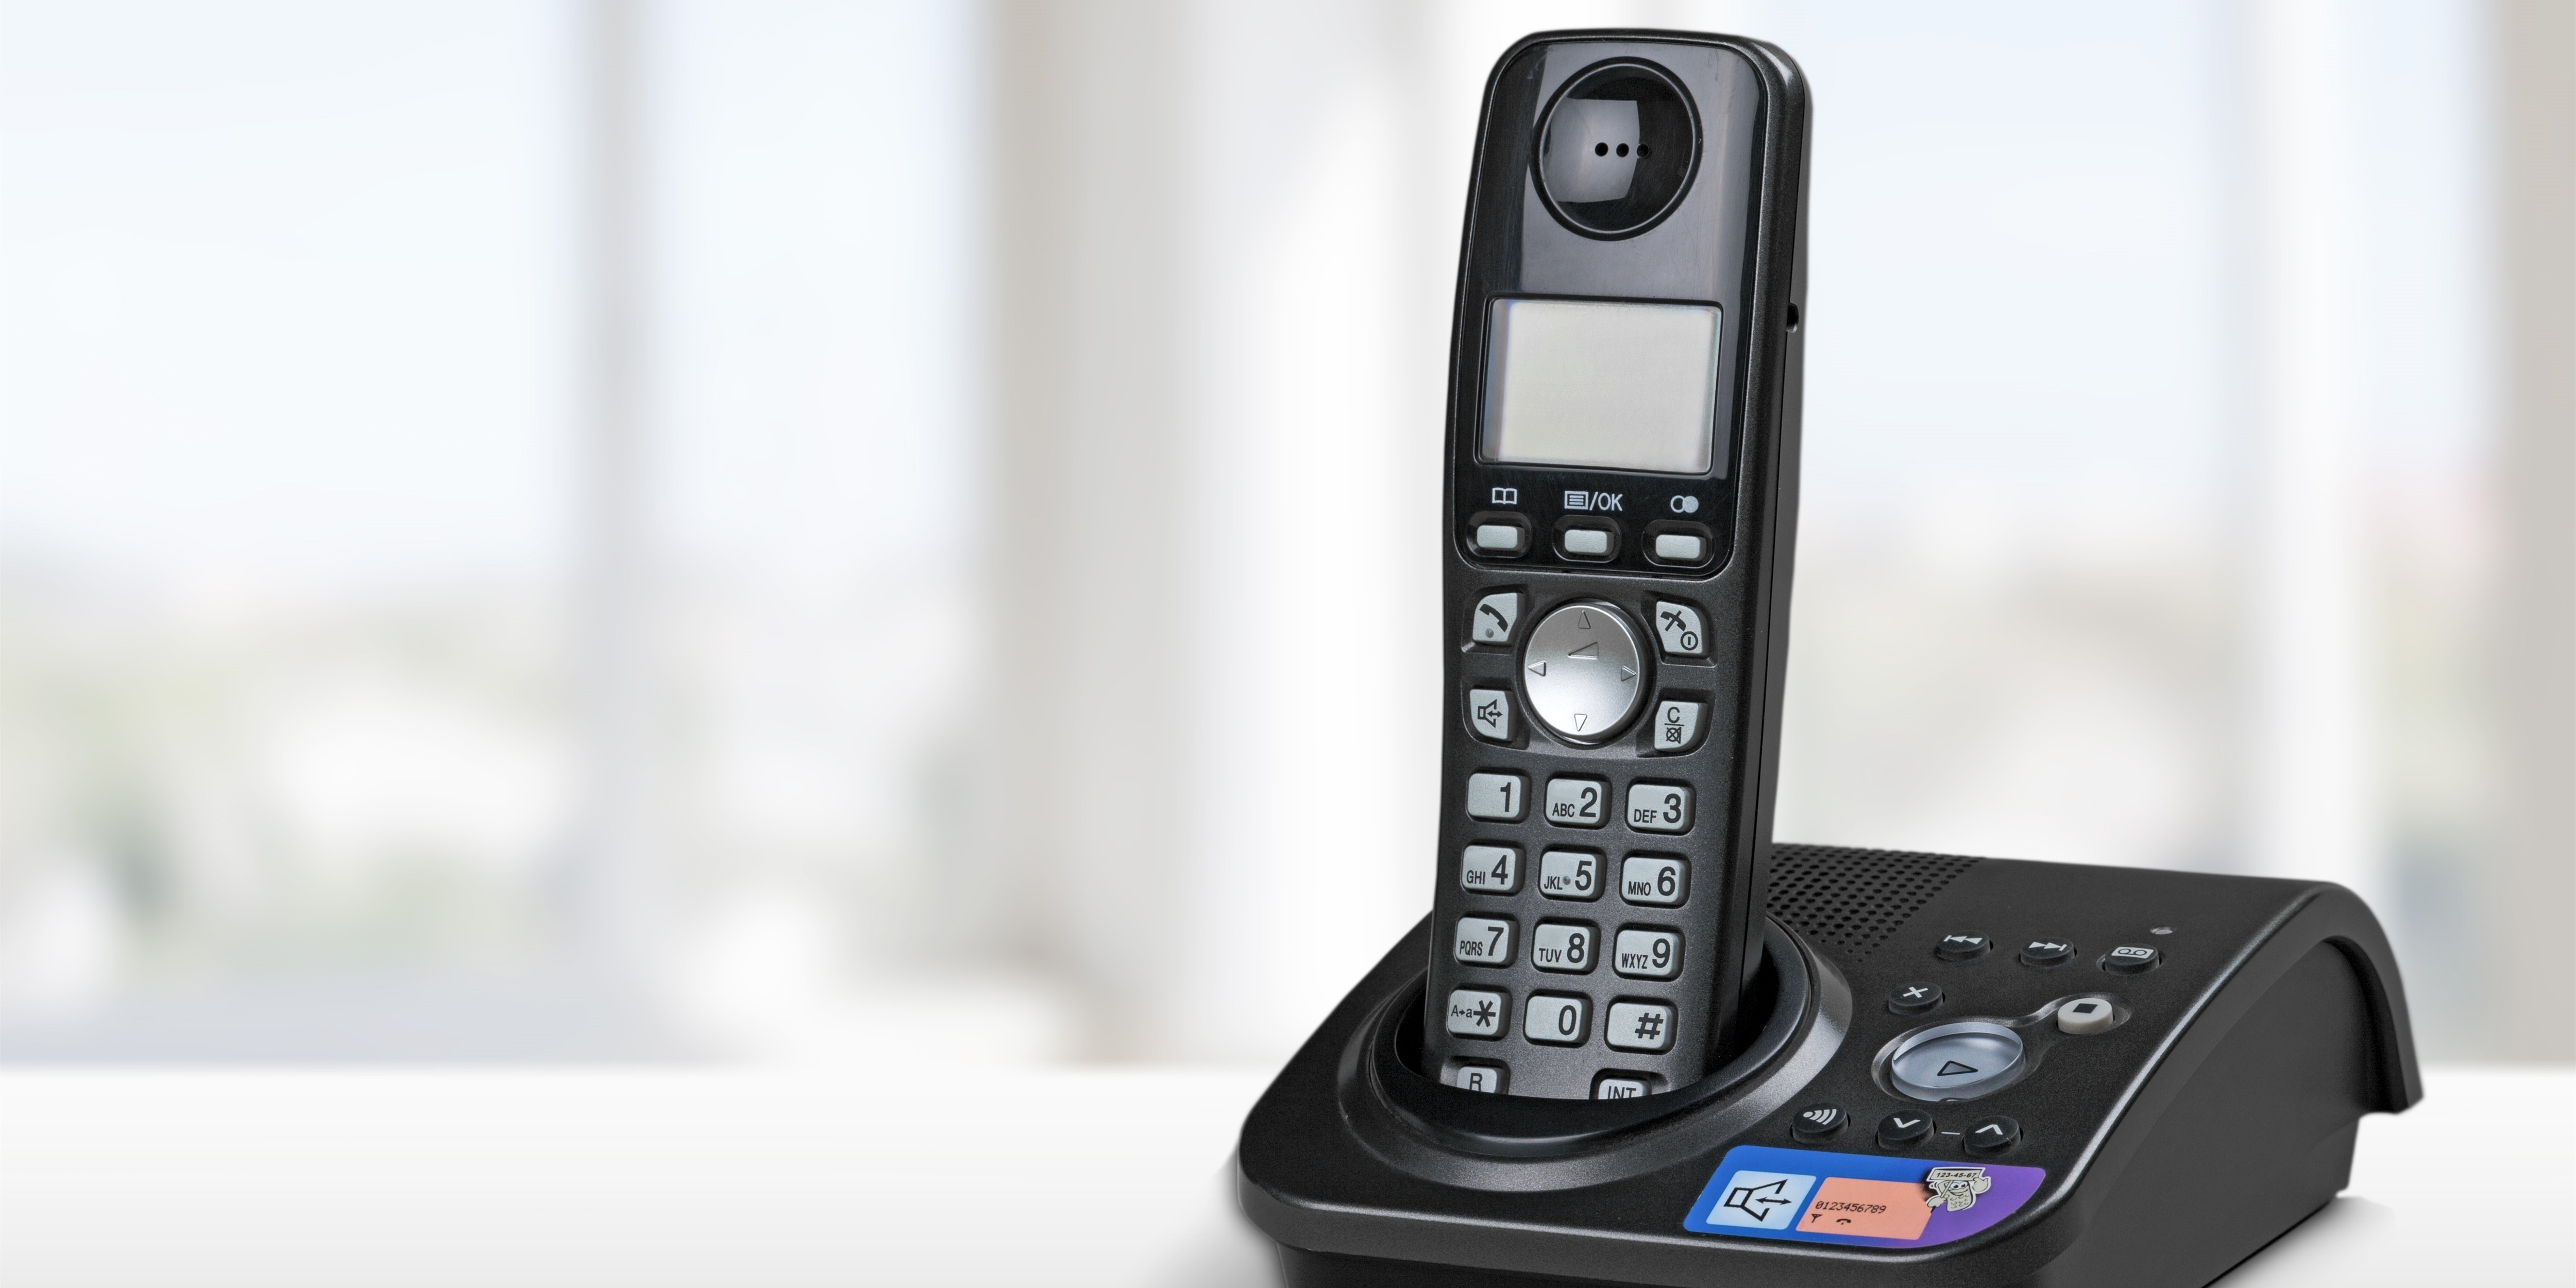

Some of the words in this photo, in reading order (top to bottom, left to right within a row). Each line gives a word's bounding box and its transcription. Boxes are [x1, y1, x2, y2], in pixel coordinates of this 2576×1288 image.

[1667, 706, 1680, 723] C
[1500, 782, 1512, 812] 1
[1552, 802, 1575, 818] ABC
[1579, 787, 1598, 818] 2
[1633, 808, 1657, 824] DEF
[1663, 793, 1682, 824] 3
[1466, 870, 1486, 885] GHI
[1491, 855, 1509, 885] 4
[1544, 875, 1563, 890] JKL
[1574, 860, 1592, 891] 5
[1628, 880, 1651, 896] MNO
[1657, 866, 1676, 896] 6
[1459, 940, 1483, 957] PQRS
[1487, 926, 1504, 956] 7
[1538, 947, 1562, 963] TUV
[1567, 933, 1585, 963] 8
[1621, 953, 1649, 969] WXYZ
[1652, 938, 1671, 969] 9
[1558, 1005, 1577, 1036] 0
[1634, 1012, 1664, 1040] #
[1469, 1073, 1483, 1091] R
[1607, 1086, 1636, 1099] INT
[1815, 1201, 1887, 1214] 0123456789
